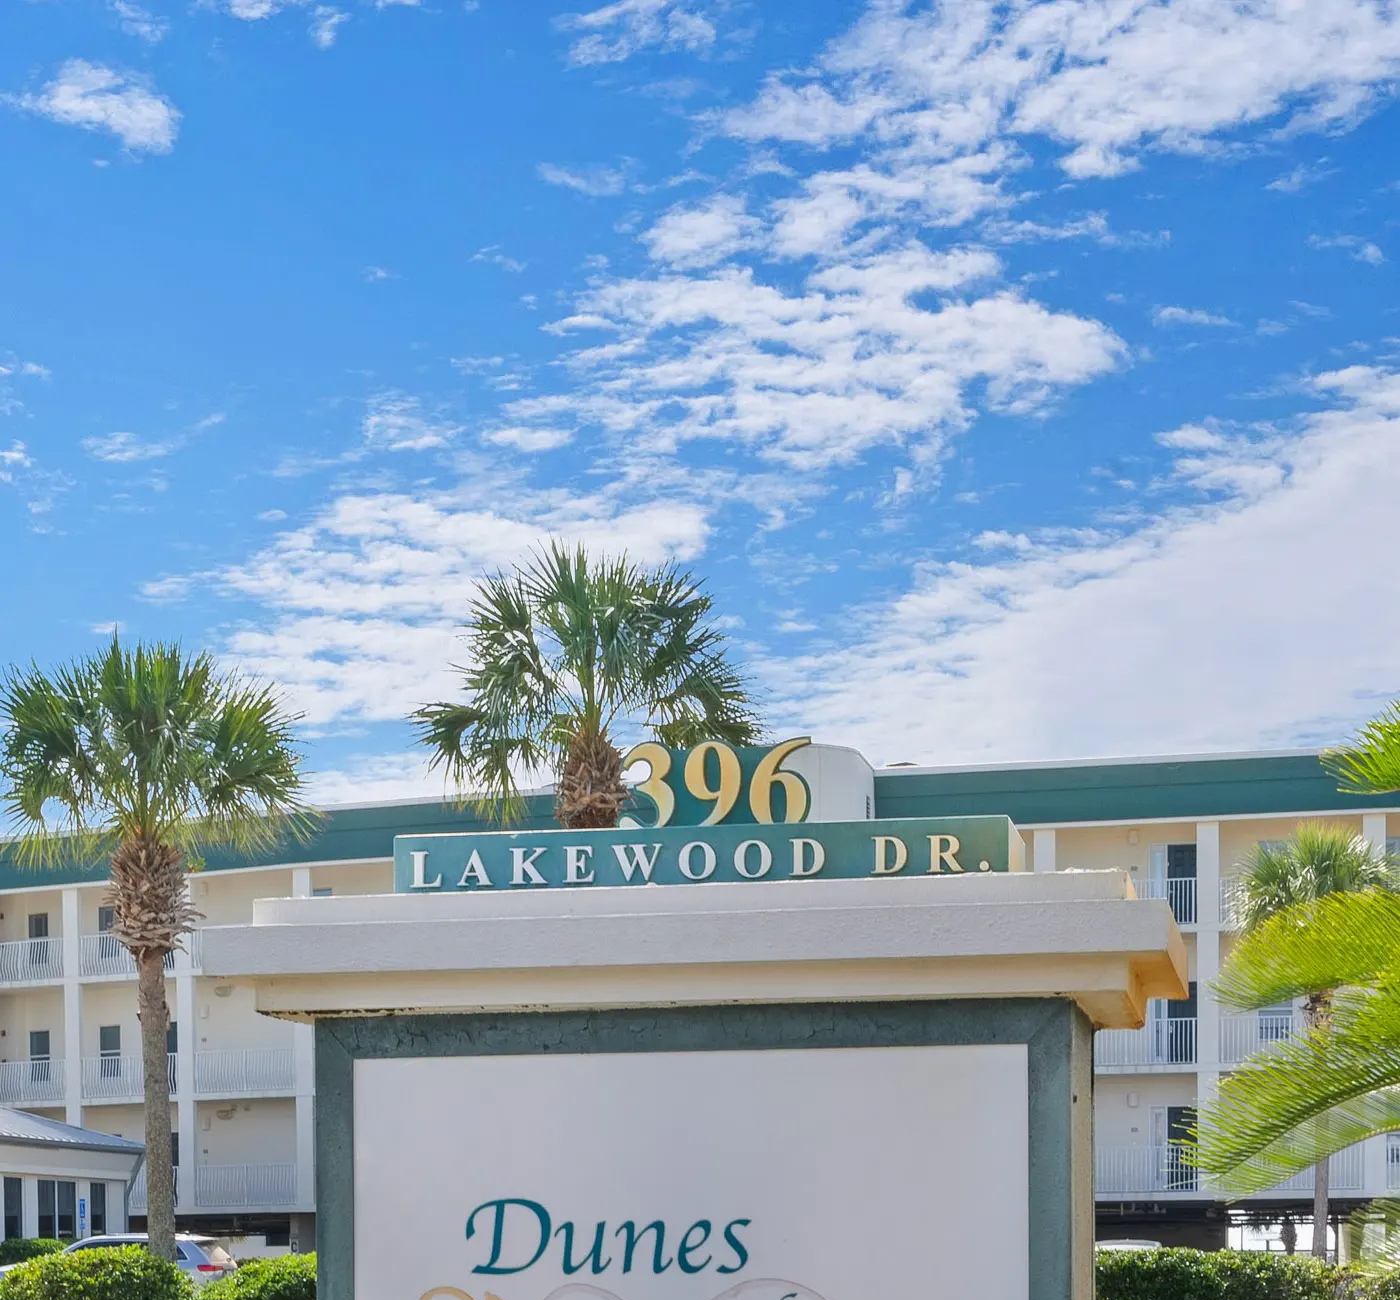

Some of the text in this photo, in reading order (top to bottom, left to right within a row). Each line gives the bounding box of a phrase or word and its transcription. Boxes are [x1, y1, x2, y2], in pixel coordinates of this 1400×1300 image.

[619, 737, 811, 828] 396
[409, 834, 992, 888] LAKEWOOD DR.
[465, 1197, 752, 1275] Dunes
